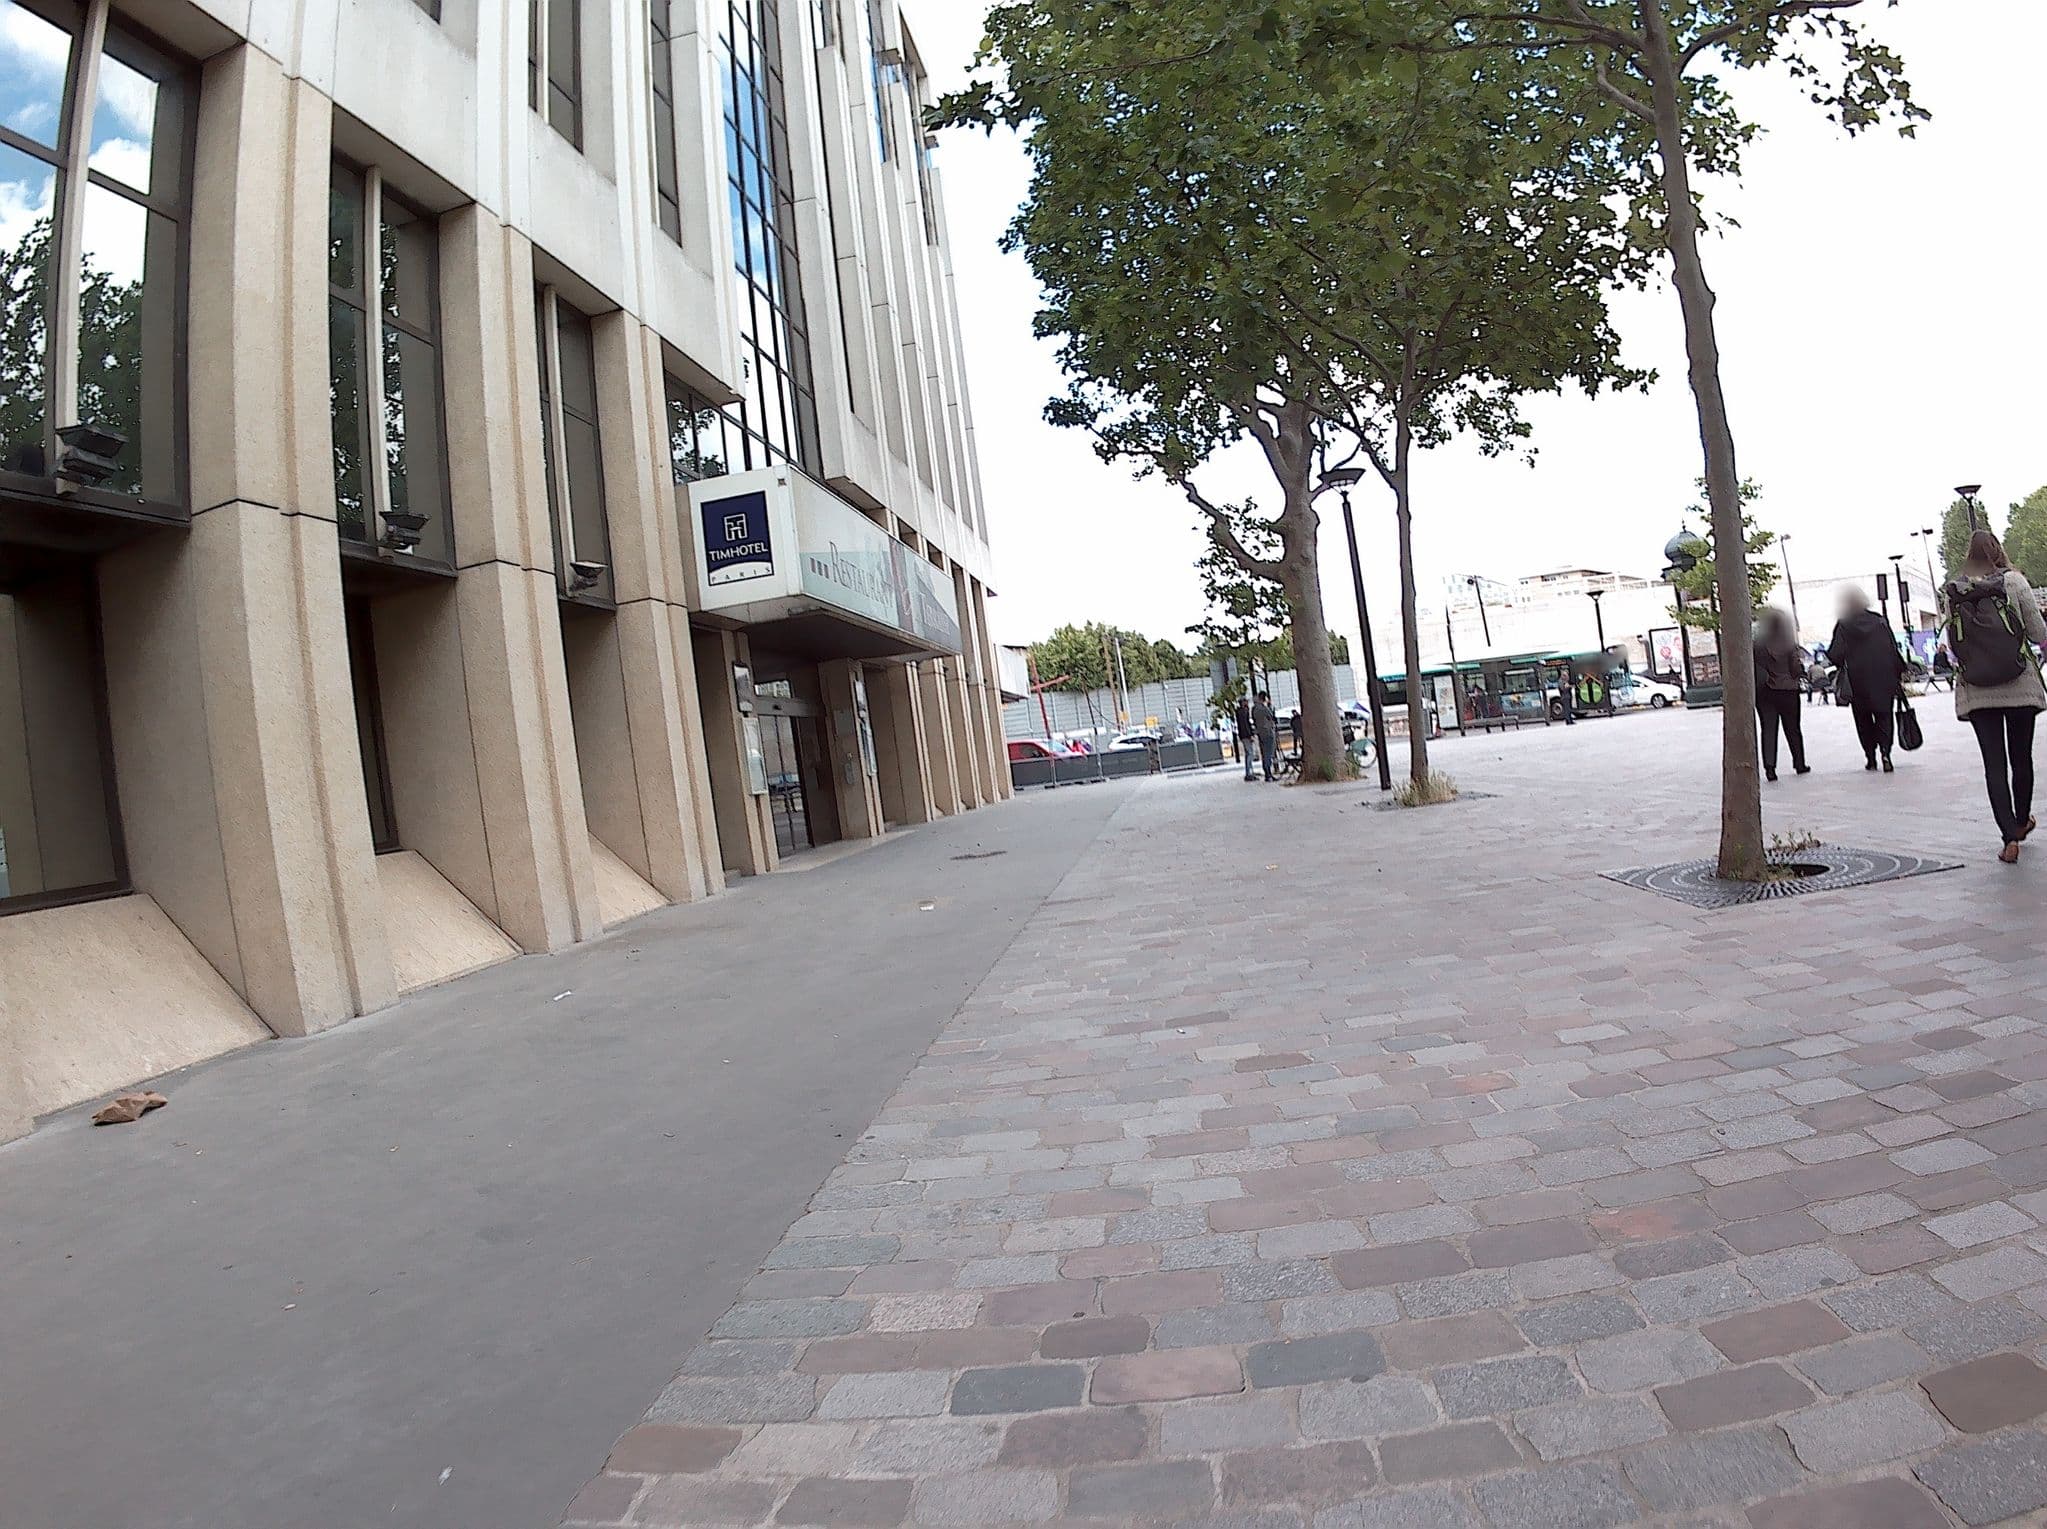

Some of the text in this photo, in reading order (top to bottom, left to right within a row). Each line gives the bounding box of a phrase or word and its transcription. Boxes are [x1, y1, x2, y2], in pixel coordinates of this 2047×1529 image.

[709, 542, 768, 561] TIMHOTEL
[711, 567, 770, 582] PARIS
[829, 541, 893, 608] RESTAURANT
